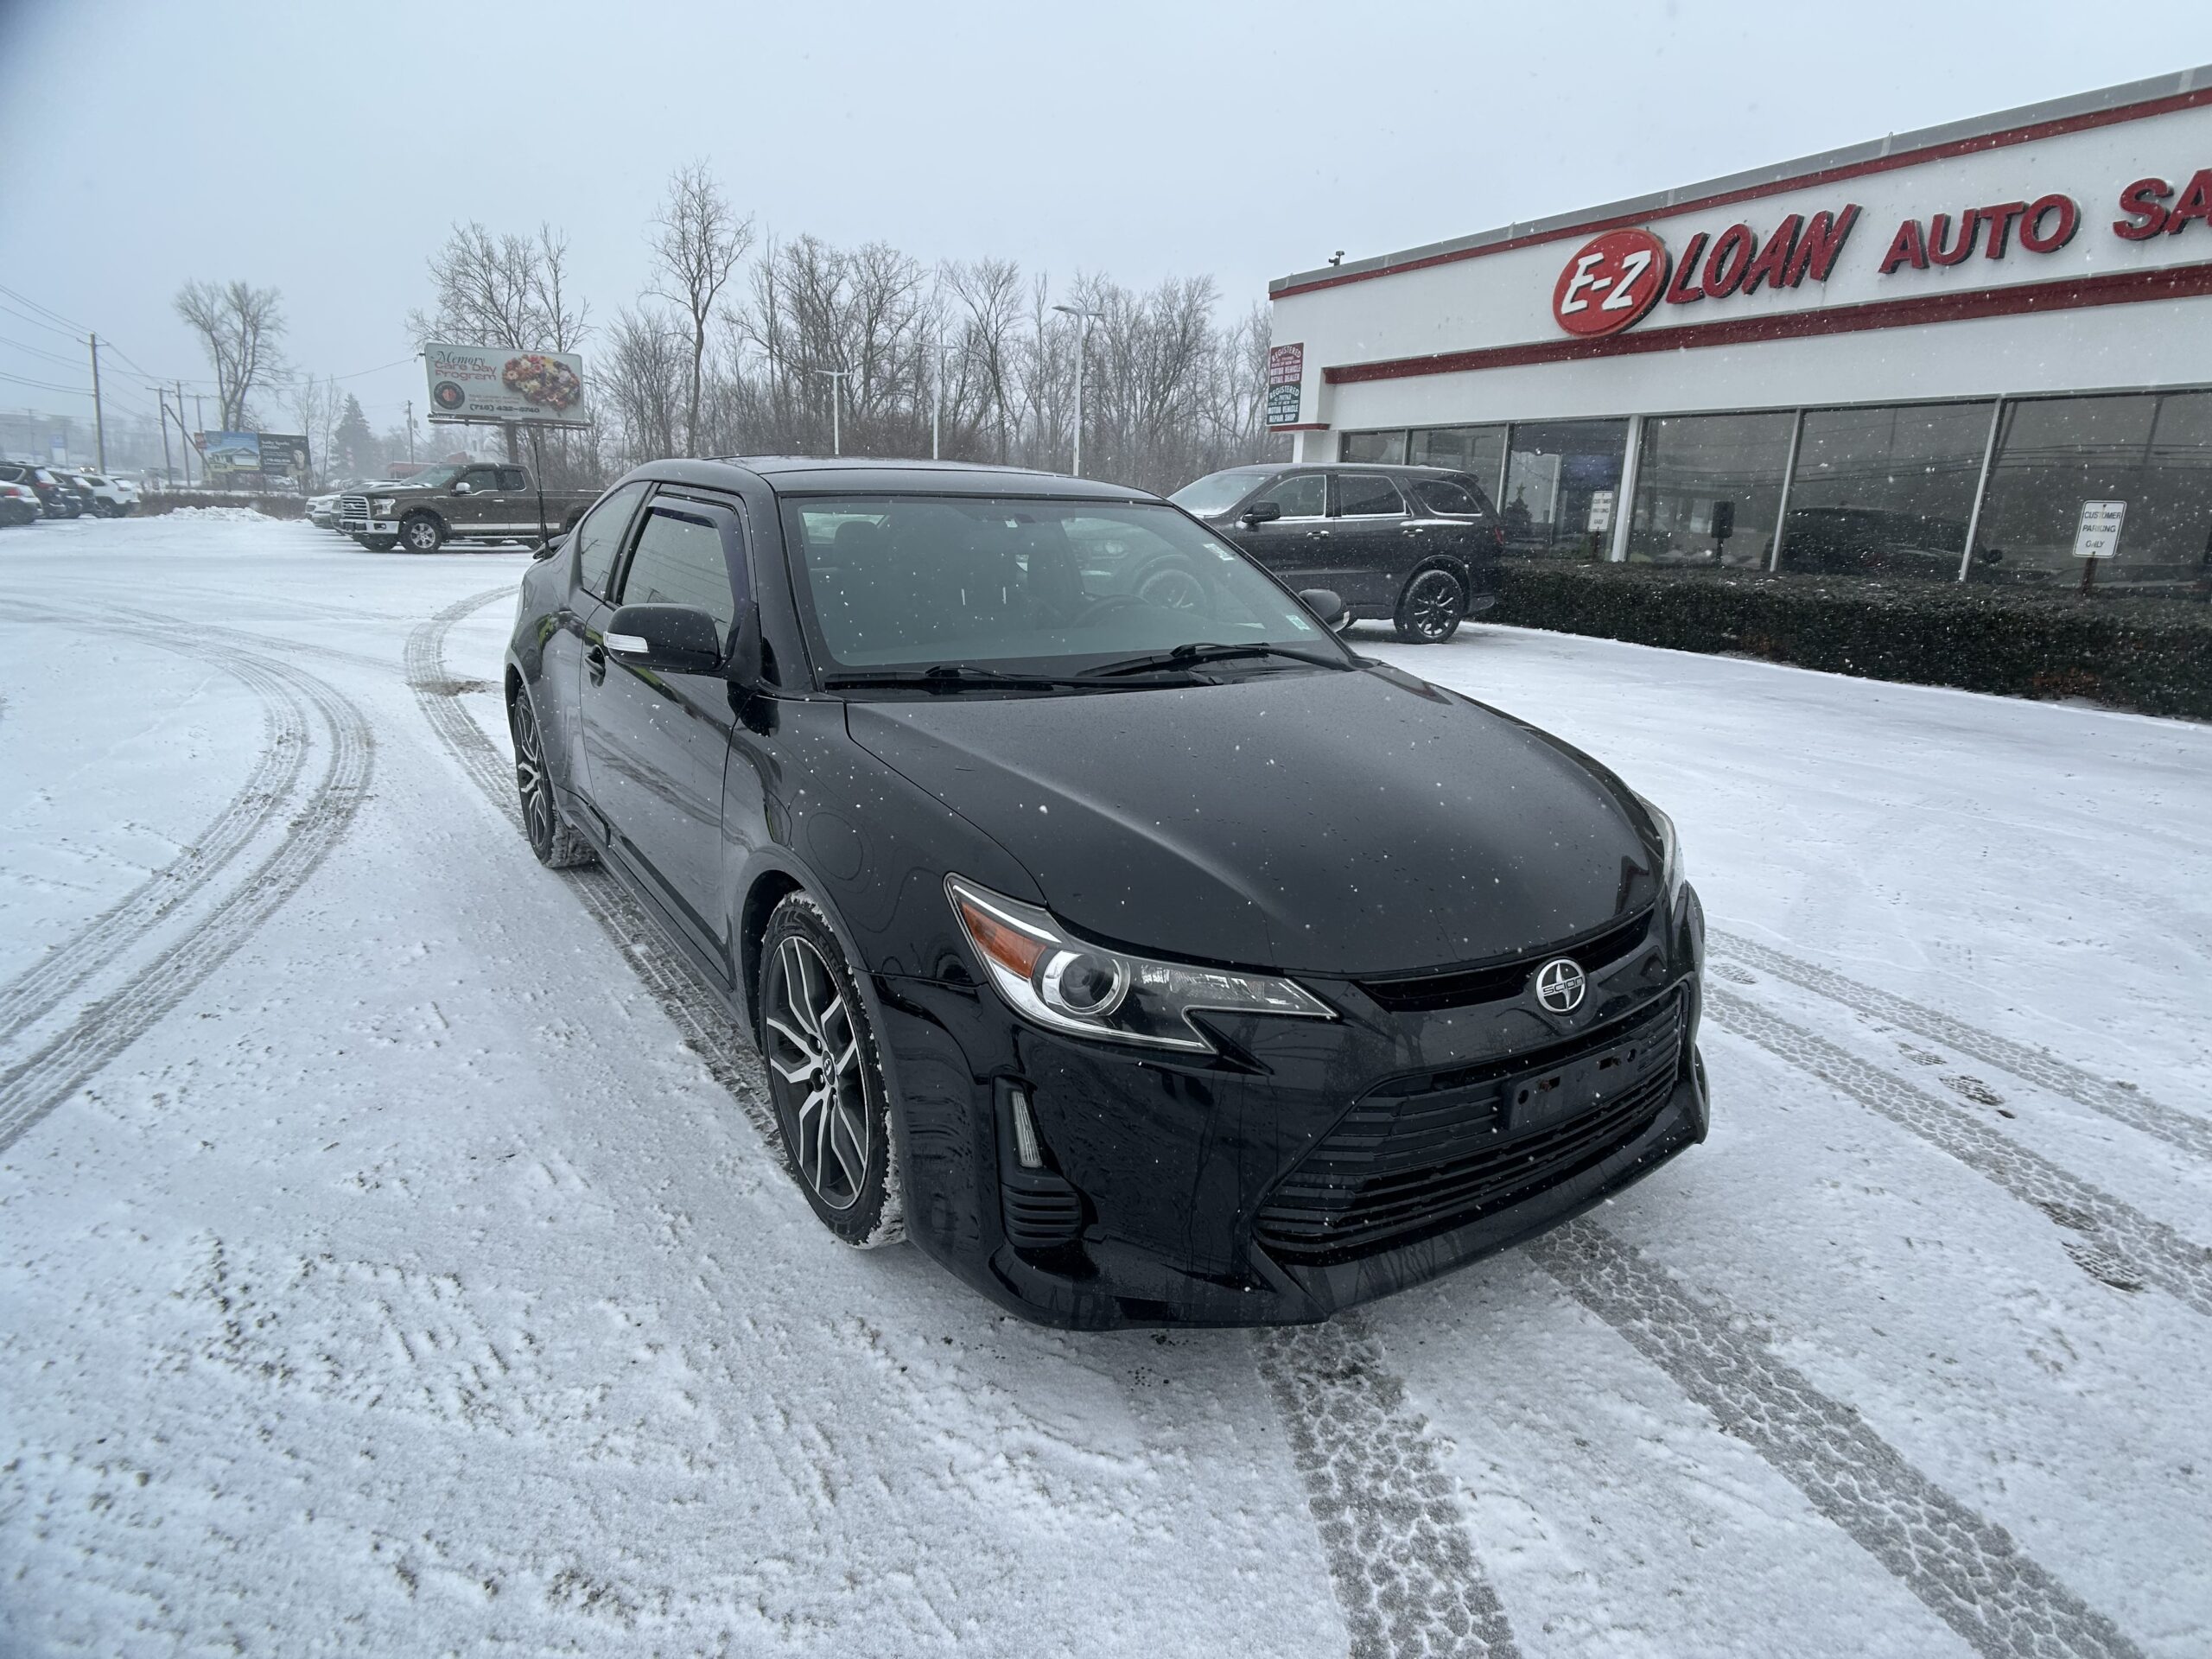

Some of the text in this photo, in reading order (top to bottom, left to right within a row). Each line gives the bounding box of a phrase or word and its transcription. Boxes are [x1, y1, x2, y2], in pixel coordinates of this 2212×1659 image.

[1560, 249, 1651, 315] E-Z
[1665, 203, 1863, 305] LOAN
[1878, 193, 2082, 275] AUTO
[431, 351, 486, 365] Memory
[1272, 346, 1301, 362] REGISTERED
[435, 360, 497, 374] Care Day
[1285, 364, 1301, 373] VEHICLE
[435, 369, 497, 381] Program
[1284, 373, 1300, 383] DEALER
[1269, 385, 1300, 399] REGISTERED
[1282, 404, 1299, 413] VEHICLE
[1269, 413, 1296, 423] REPAIR SHOP
[1543, 977, 1583, 995] SCION
